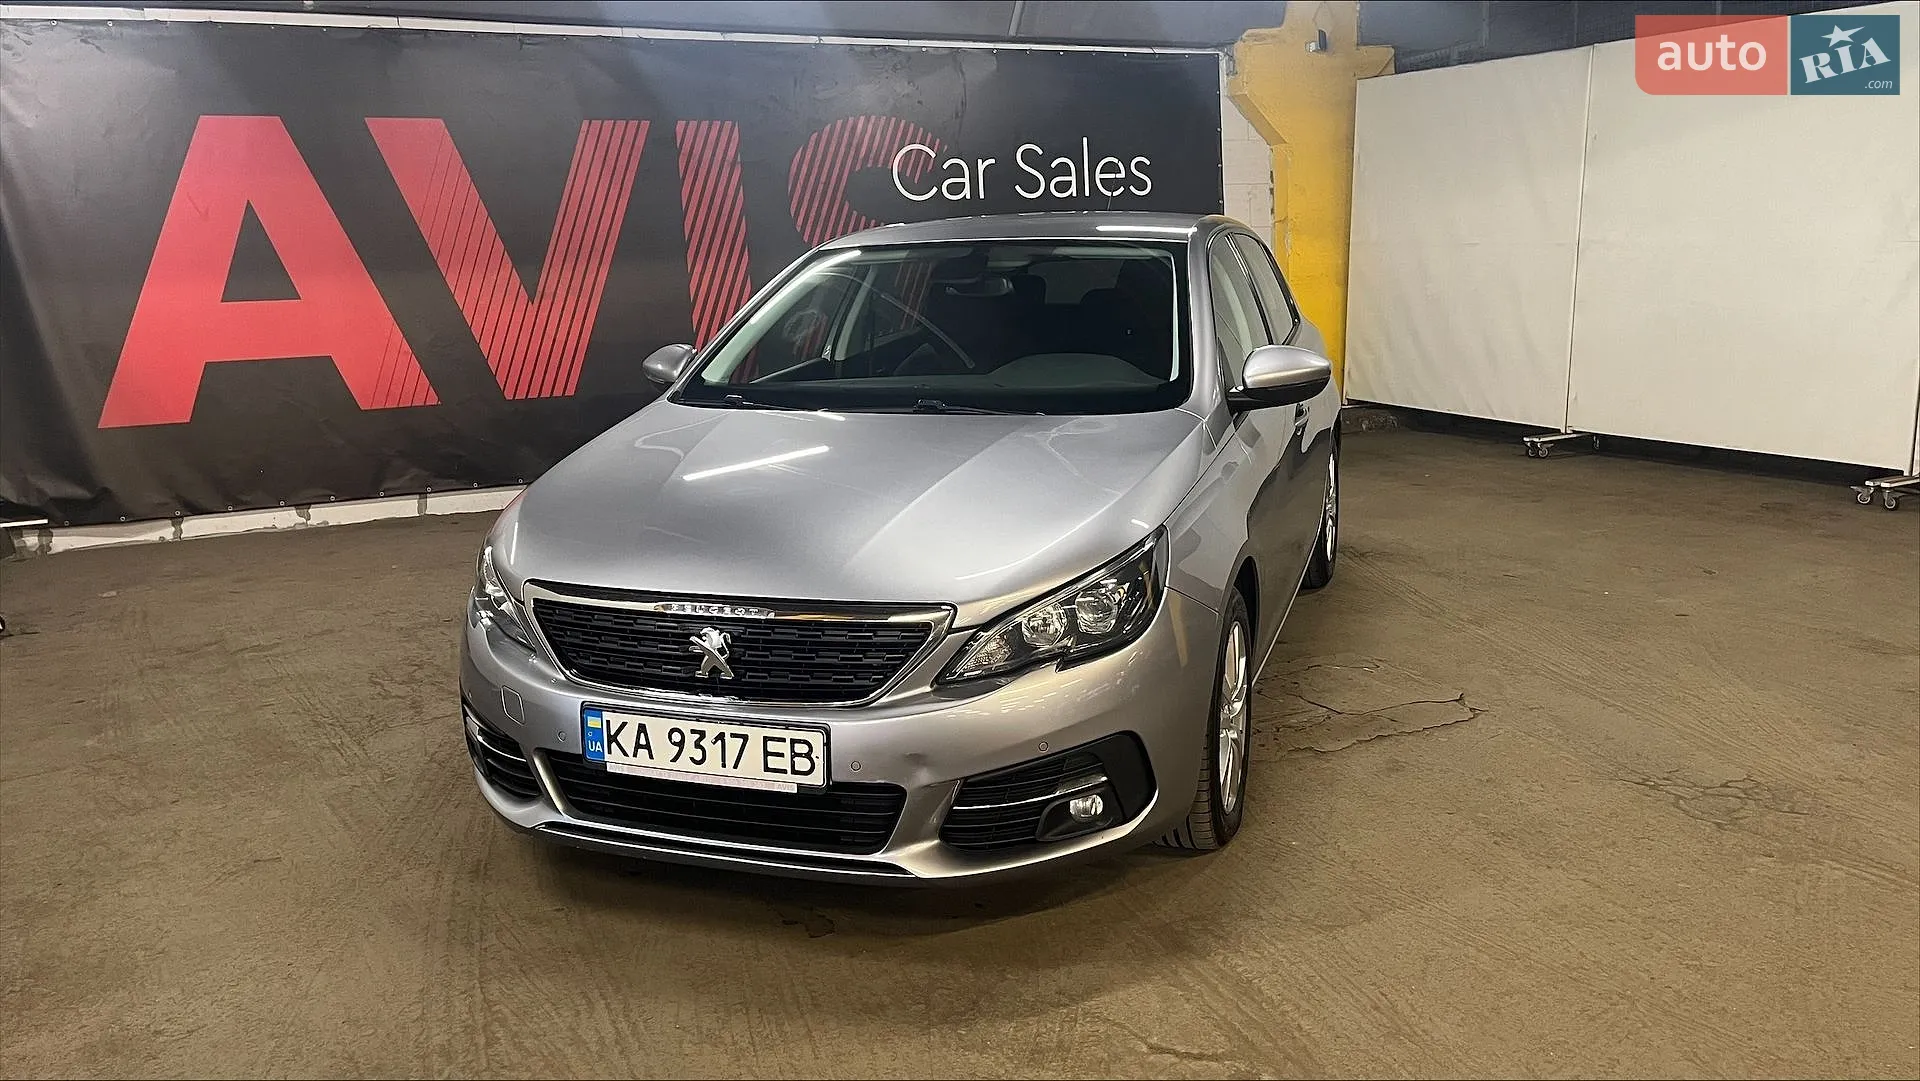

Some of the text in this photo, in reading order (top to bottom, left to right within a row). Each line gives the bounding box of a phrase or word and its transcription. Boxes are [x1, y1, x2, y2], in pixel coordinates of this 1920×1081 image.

[891, 136, 1152, 201] Car Sales
[98, 114, 947, 429] AVIS
[587, 739, 603, 754] UA
[605, 719, 816, 776] KA 9317 EB
